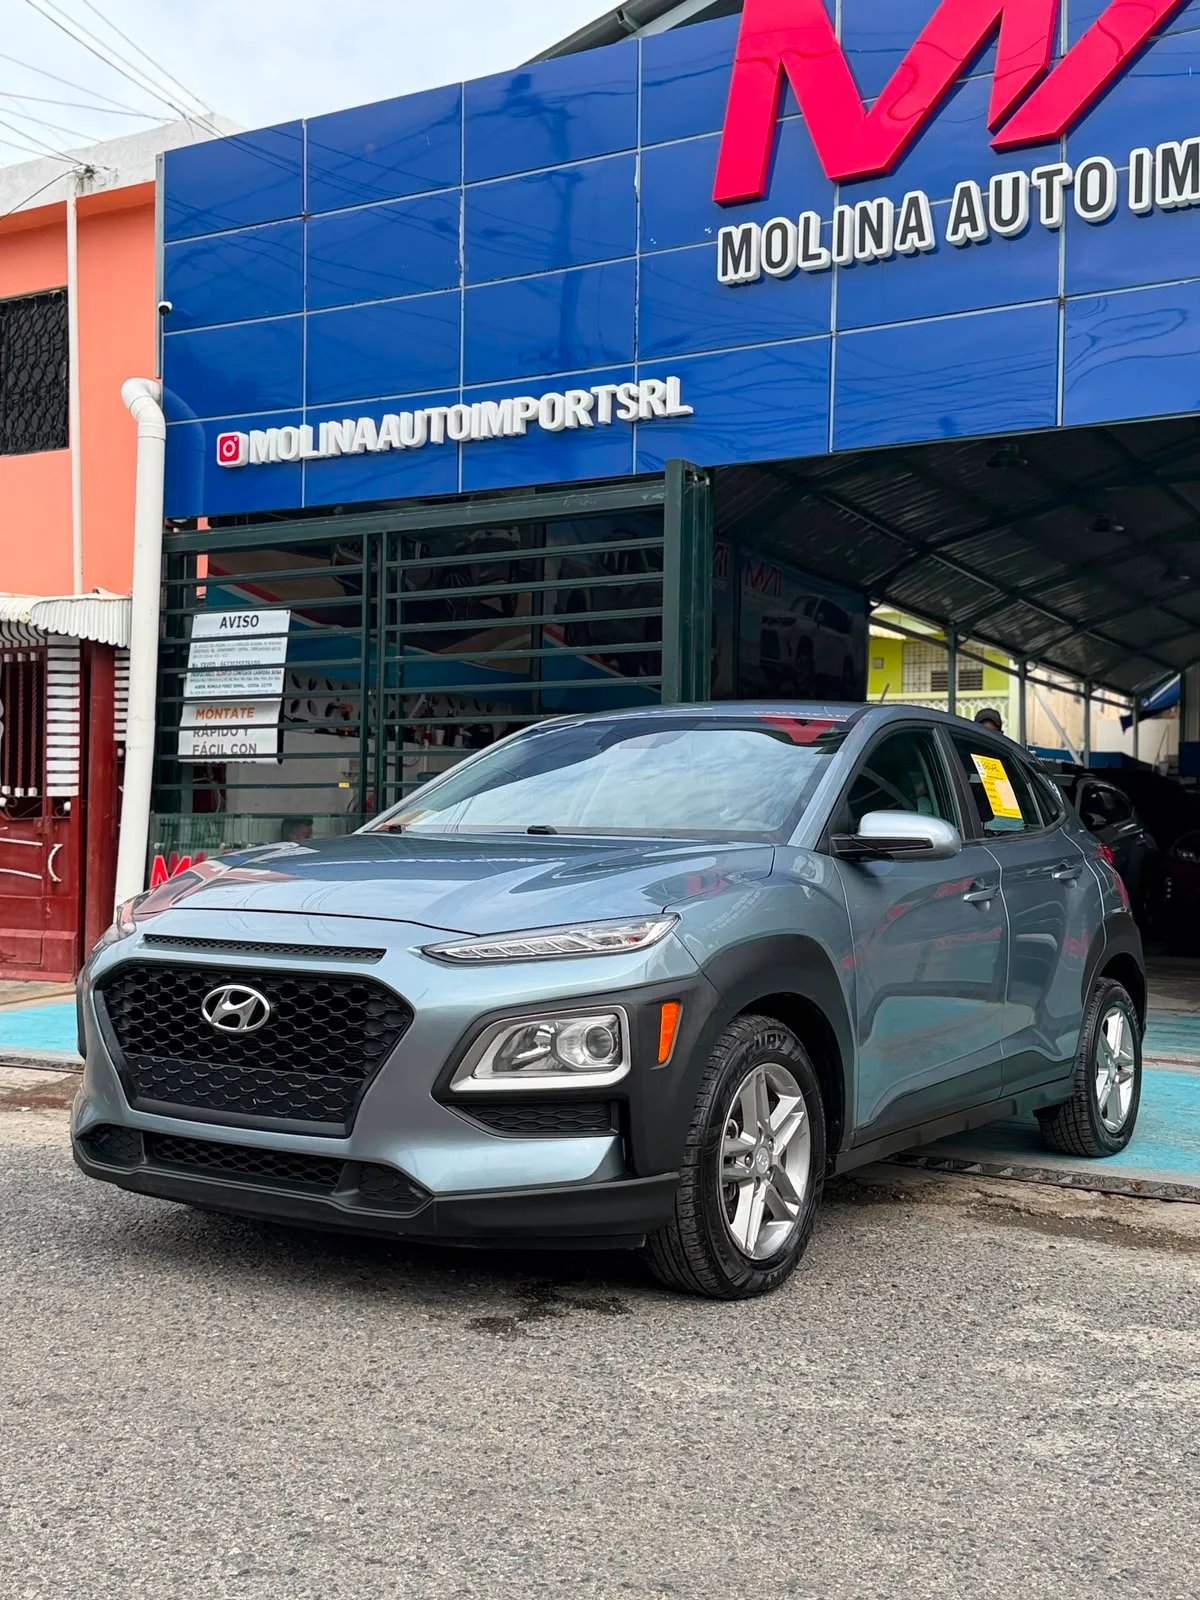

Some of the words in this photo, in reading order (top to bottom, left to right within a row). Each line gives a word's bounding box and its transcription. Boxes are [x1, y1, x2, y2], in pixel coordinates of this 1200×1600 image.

[717, 190, 936, 285] MOLINA
[946, 156, 1118, 248] AUTO
[248, 376, 693, 465] MOLINAAUTOIMPORTSRL
[219, 614, 260, 629] AVISO
[195, 705, 256, 720] MÓNTATE
[192, 741, 227, 755] FÁCIL
[230, 743, 257, 755] CON
